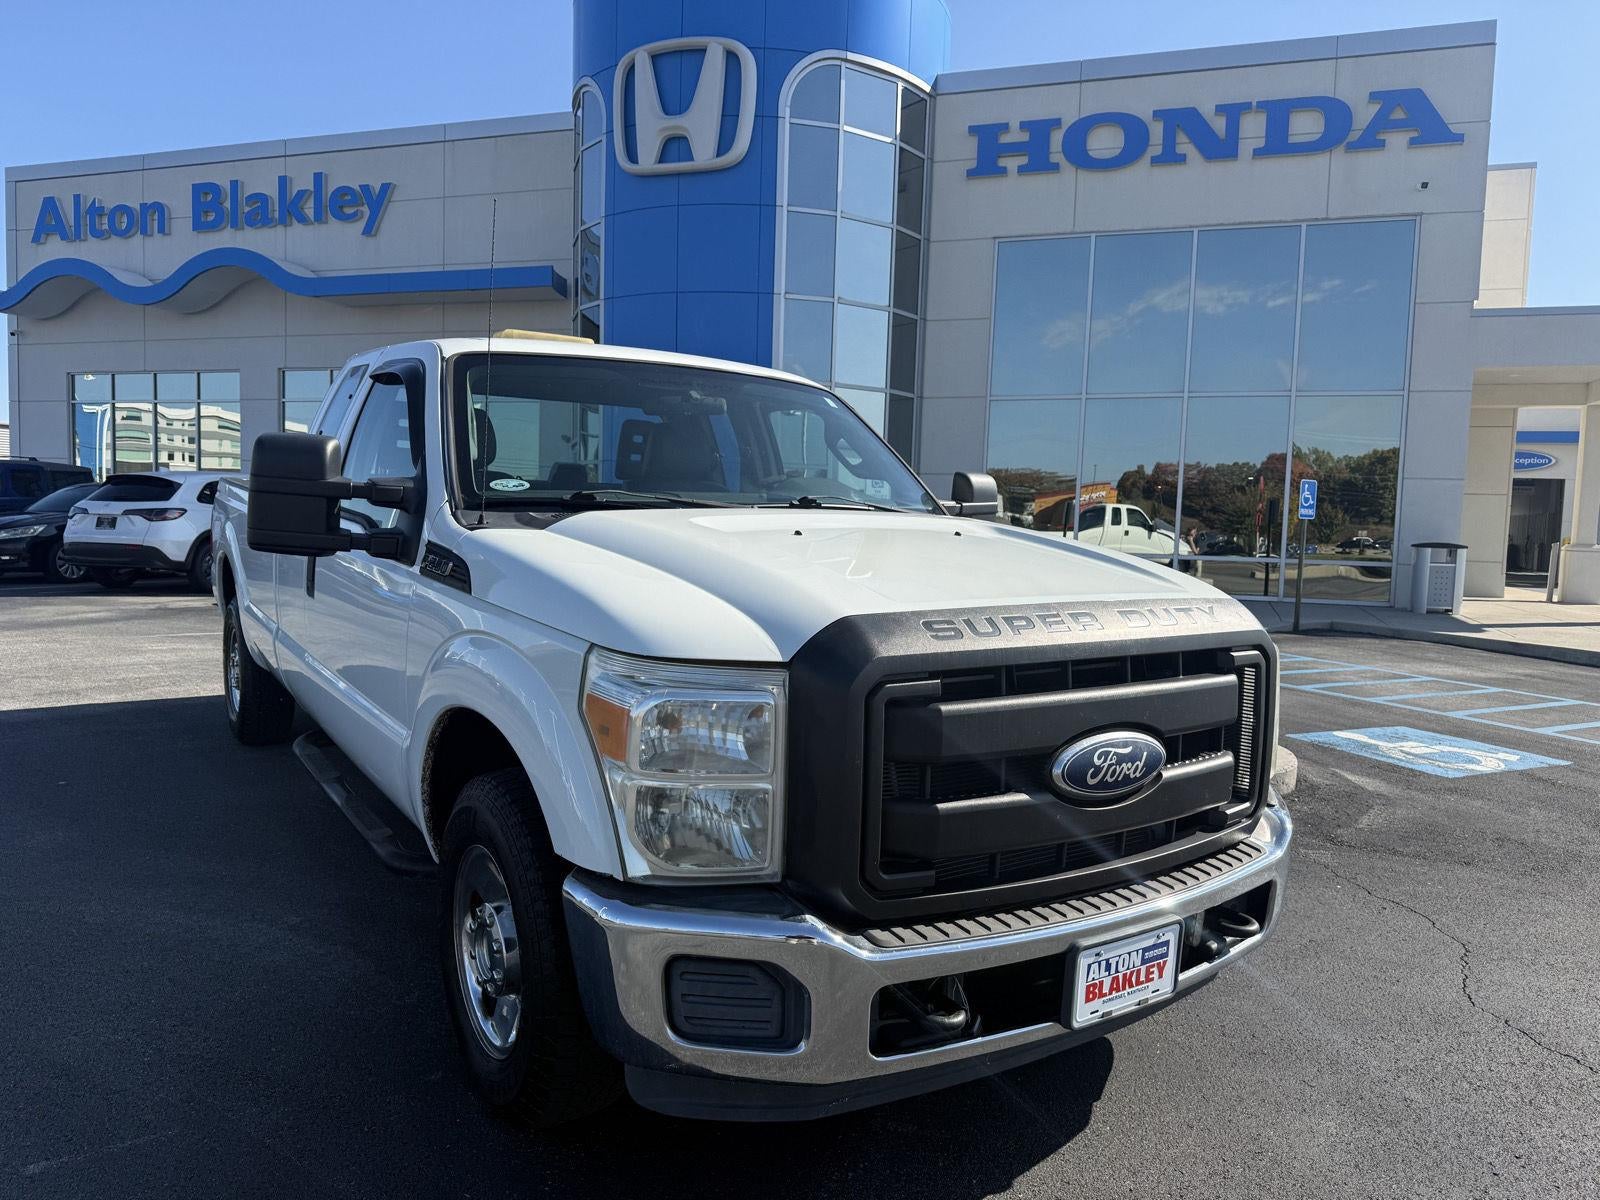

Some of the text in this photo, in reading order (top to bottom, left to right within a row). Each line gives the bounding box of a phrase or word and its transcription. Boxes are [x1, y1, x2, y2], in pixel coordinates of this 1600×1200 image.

[966, 87, 1464, 178] HONDA
[31, 172, 394, 243] Alton Blakley
[1514, 457, 1549, 466] ception
[920, 604, 1218, 641] SUPER DUTY
[1086, 745, 1148, 785] Ford
[1085, 959, 1168, 1004] BLAKLEY
[1087, 949, 1142, 982] ALTON
